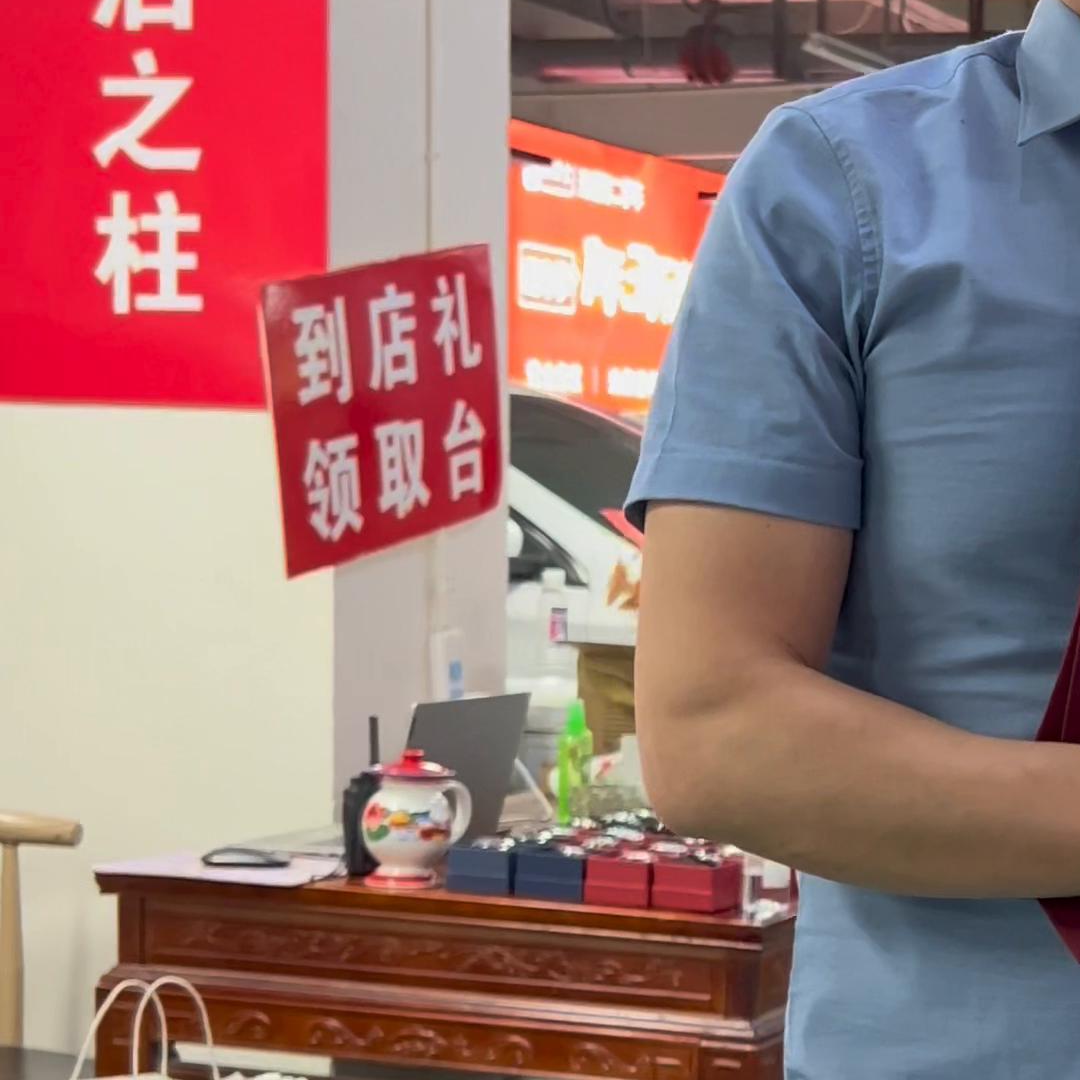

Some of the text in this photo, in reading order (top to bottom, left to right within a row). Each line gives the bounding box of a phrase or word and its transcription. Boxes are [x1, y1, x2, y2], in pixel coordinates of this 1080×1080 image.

[290, 272, 483, 406] 到店礼
[301, 398, 488, 542] 领取台
